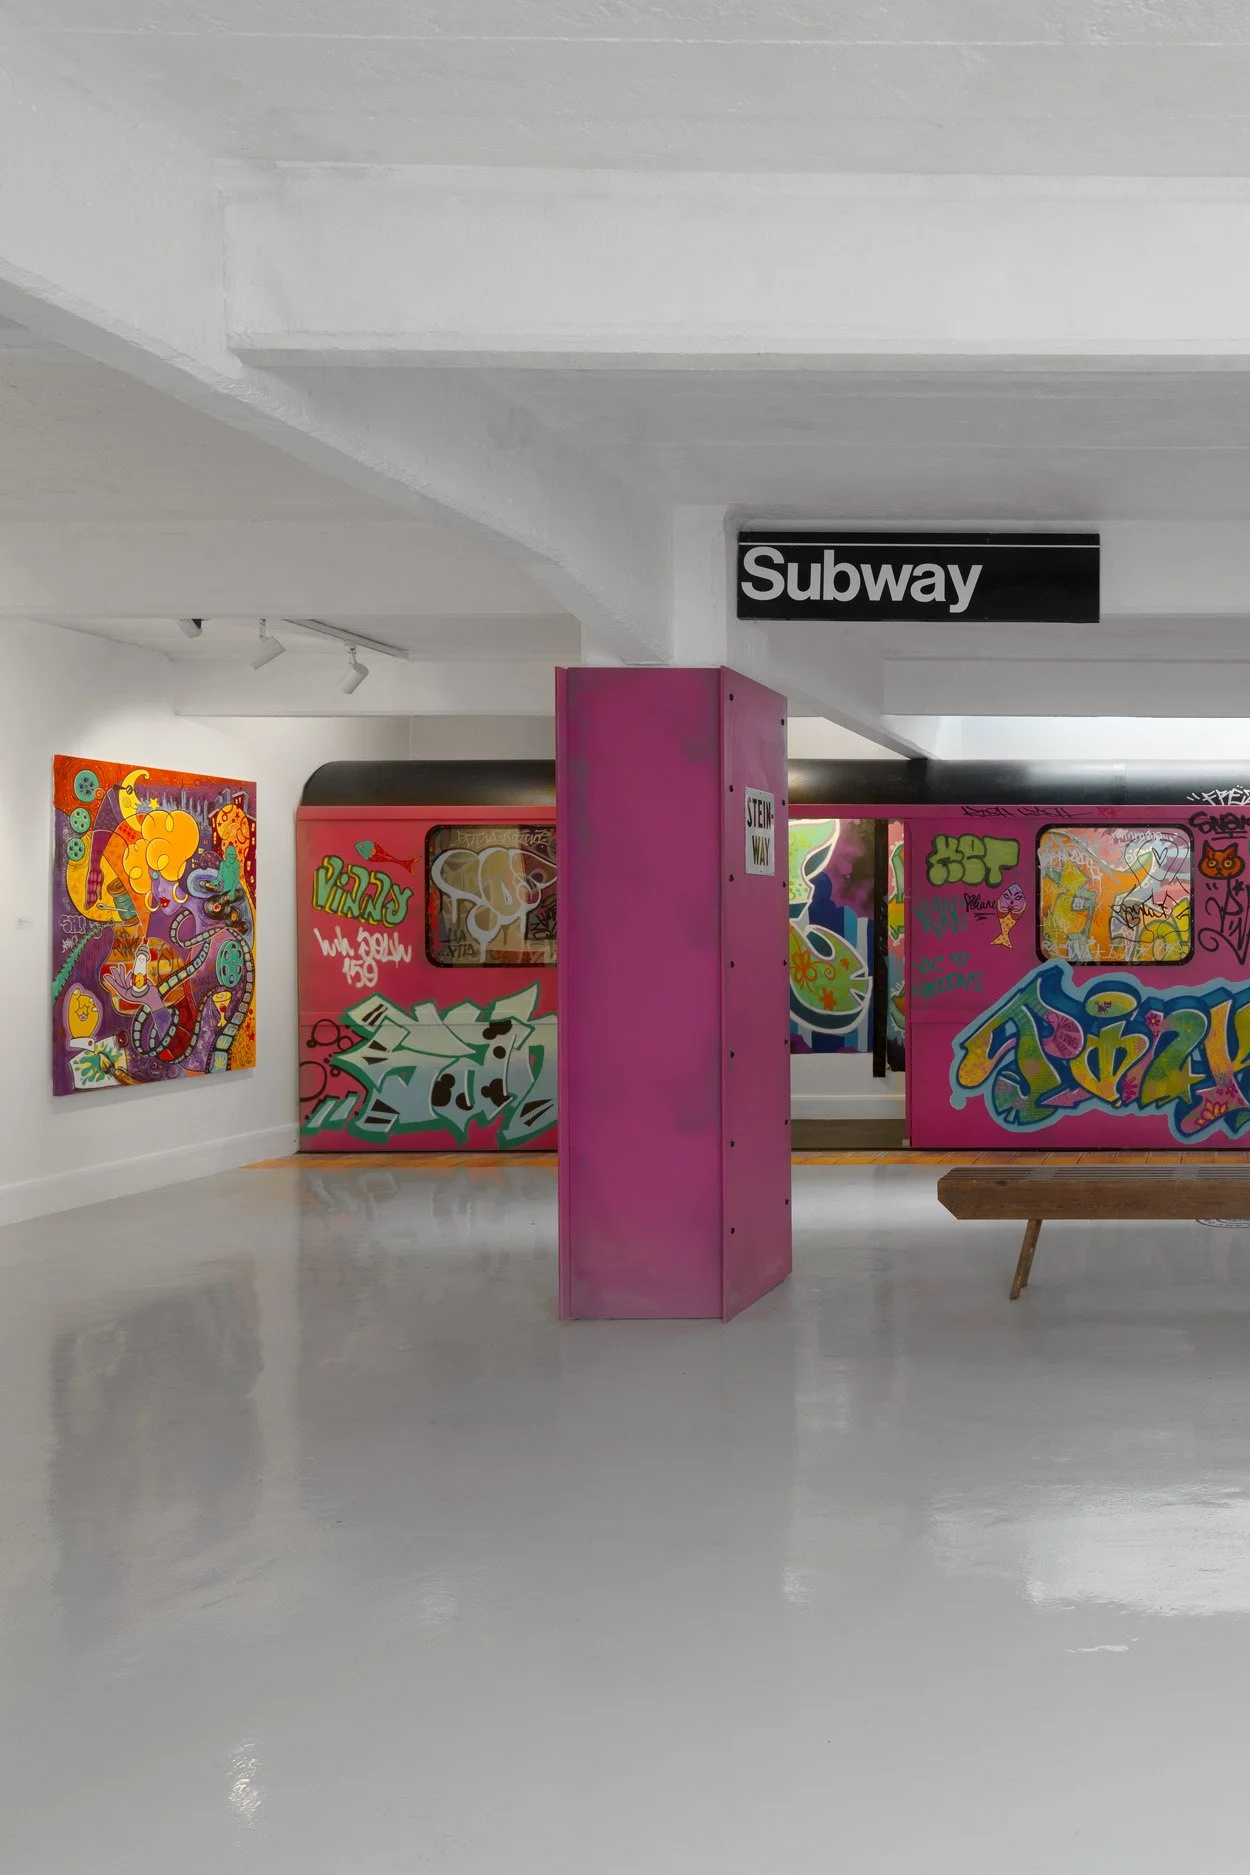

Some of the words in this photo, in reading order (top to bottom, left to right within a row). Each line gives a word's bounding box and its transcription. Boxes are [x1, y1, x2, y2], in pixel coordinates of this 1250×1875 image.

[740, 546, 983, 614] Subway
[746, 796, 774, 830] STEIN-
[752, 834, 771, 867] WAY
